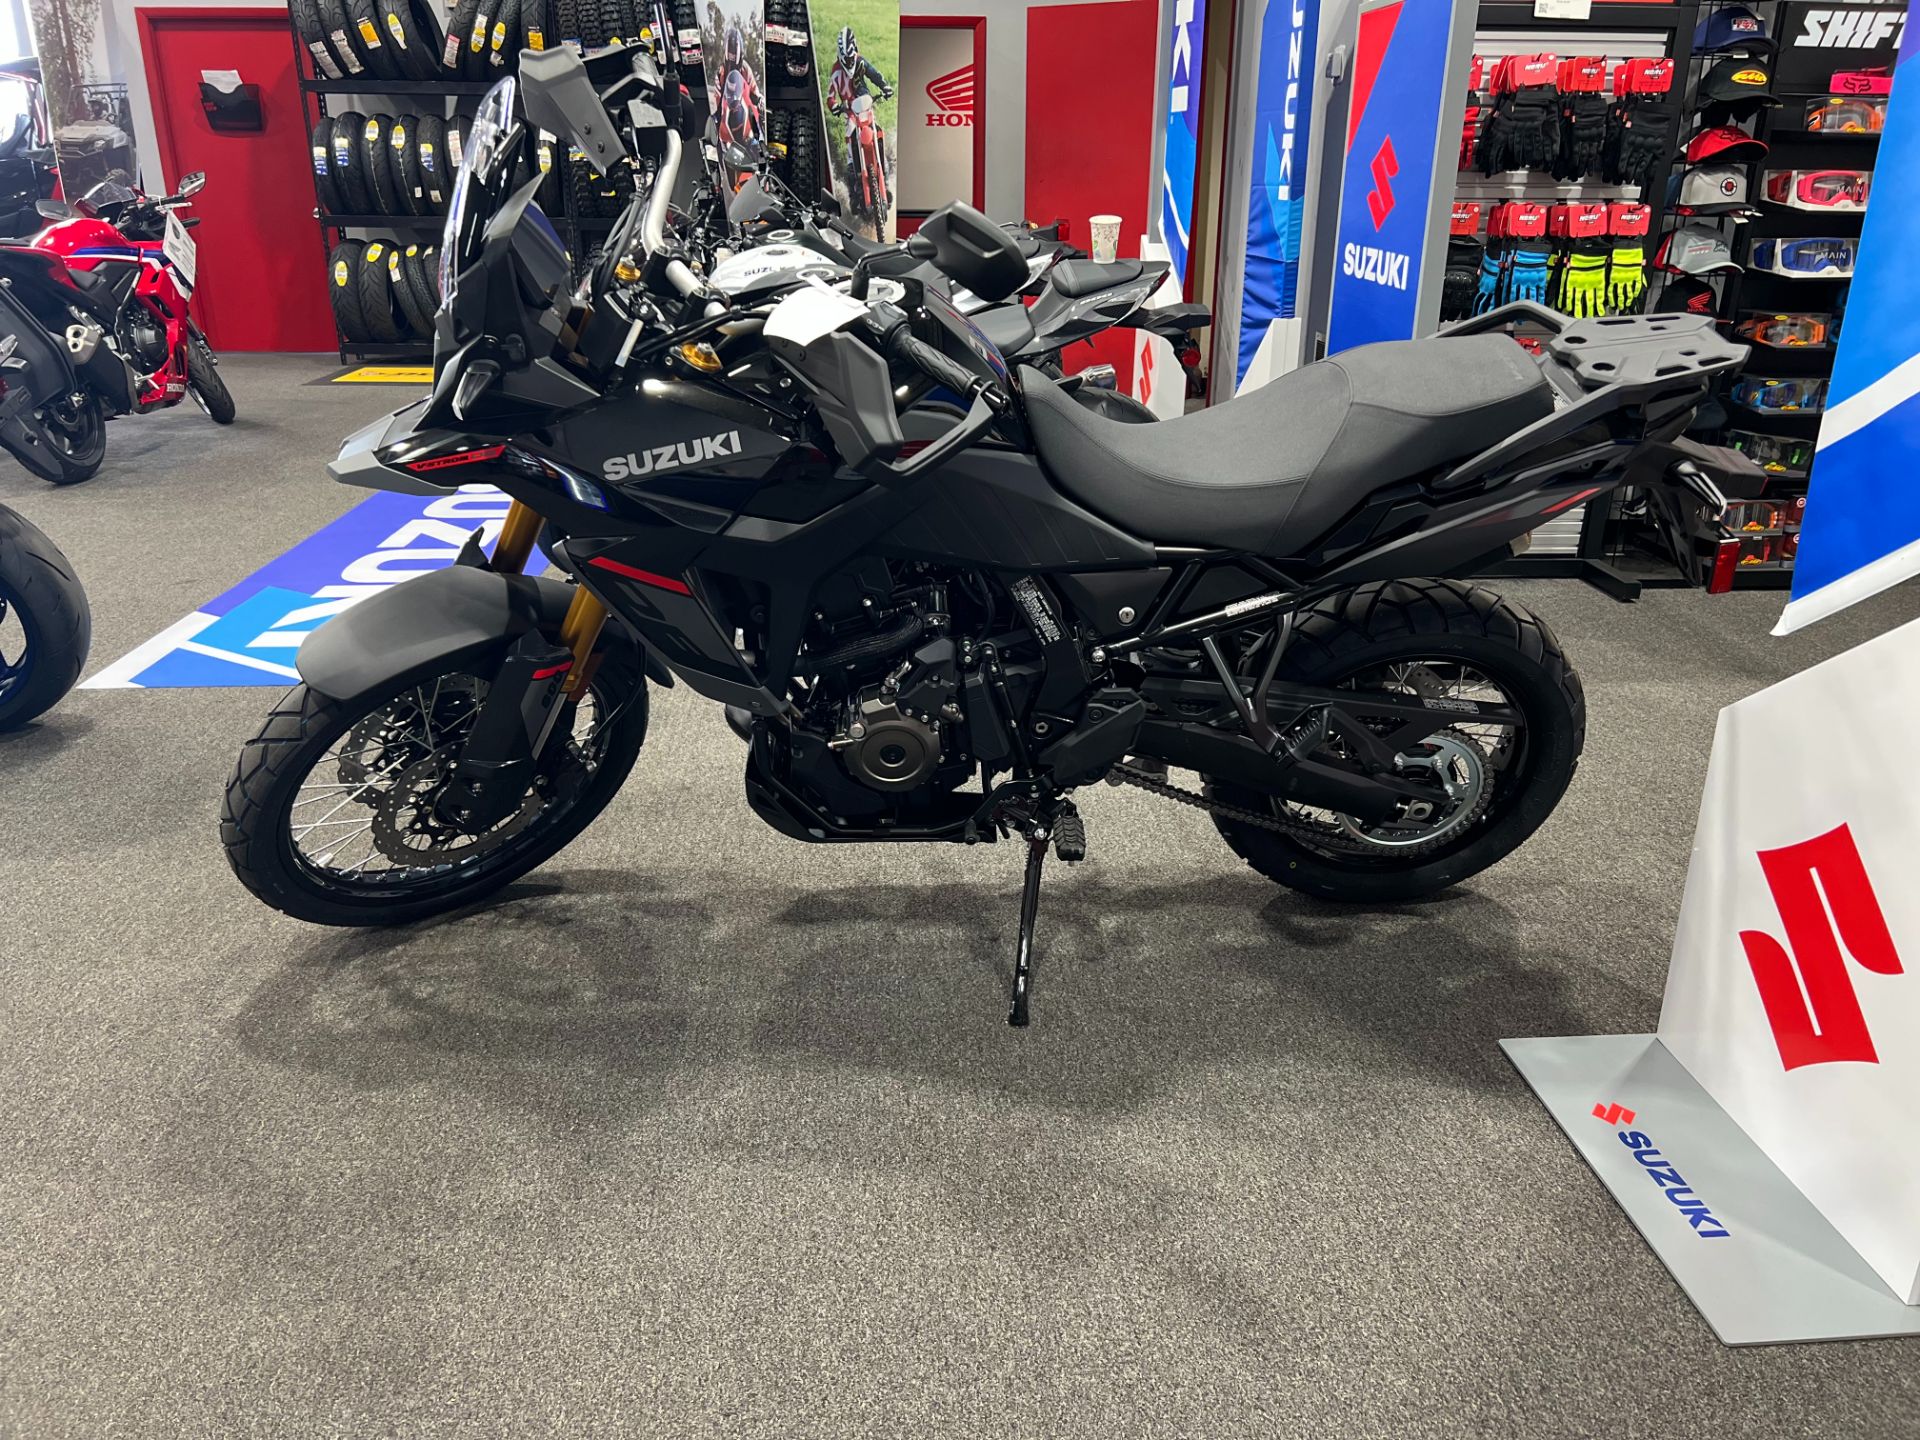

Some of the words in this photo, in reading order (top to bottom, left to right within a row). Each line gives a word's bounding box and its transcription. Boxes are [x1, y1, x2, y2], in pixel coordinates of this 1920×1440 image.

[1836, 185, 1863, 193] MAIN
[1343, 243, 1409, 291] SUZUKI
[1821, 251, 1847, 259] MAIN
[602, 430, 742, 481] SUZUKI
[1617, 1130, 1731, 1239] SUZUKI
